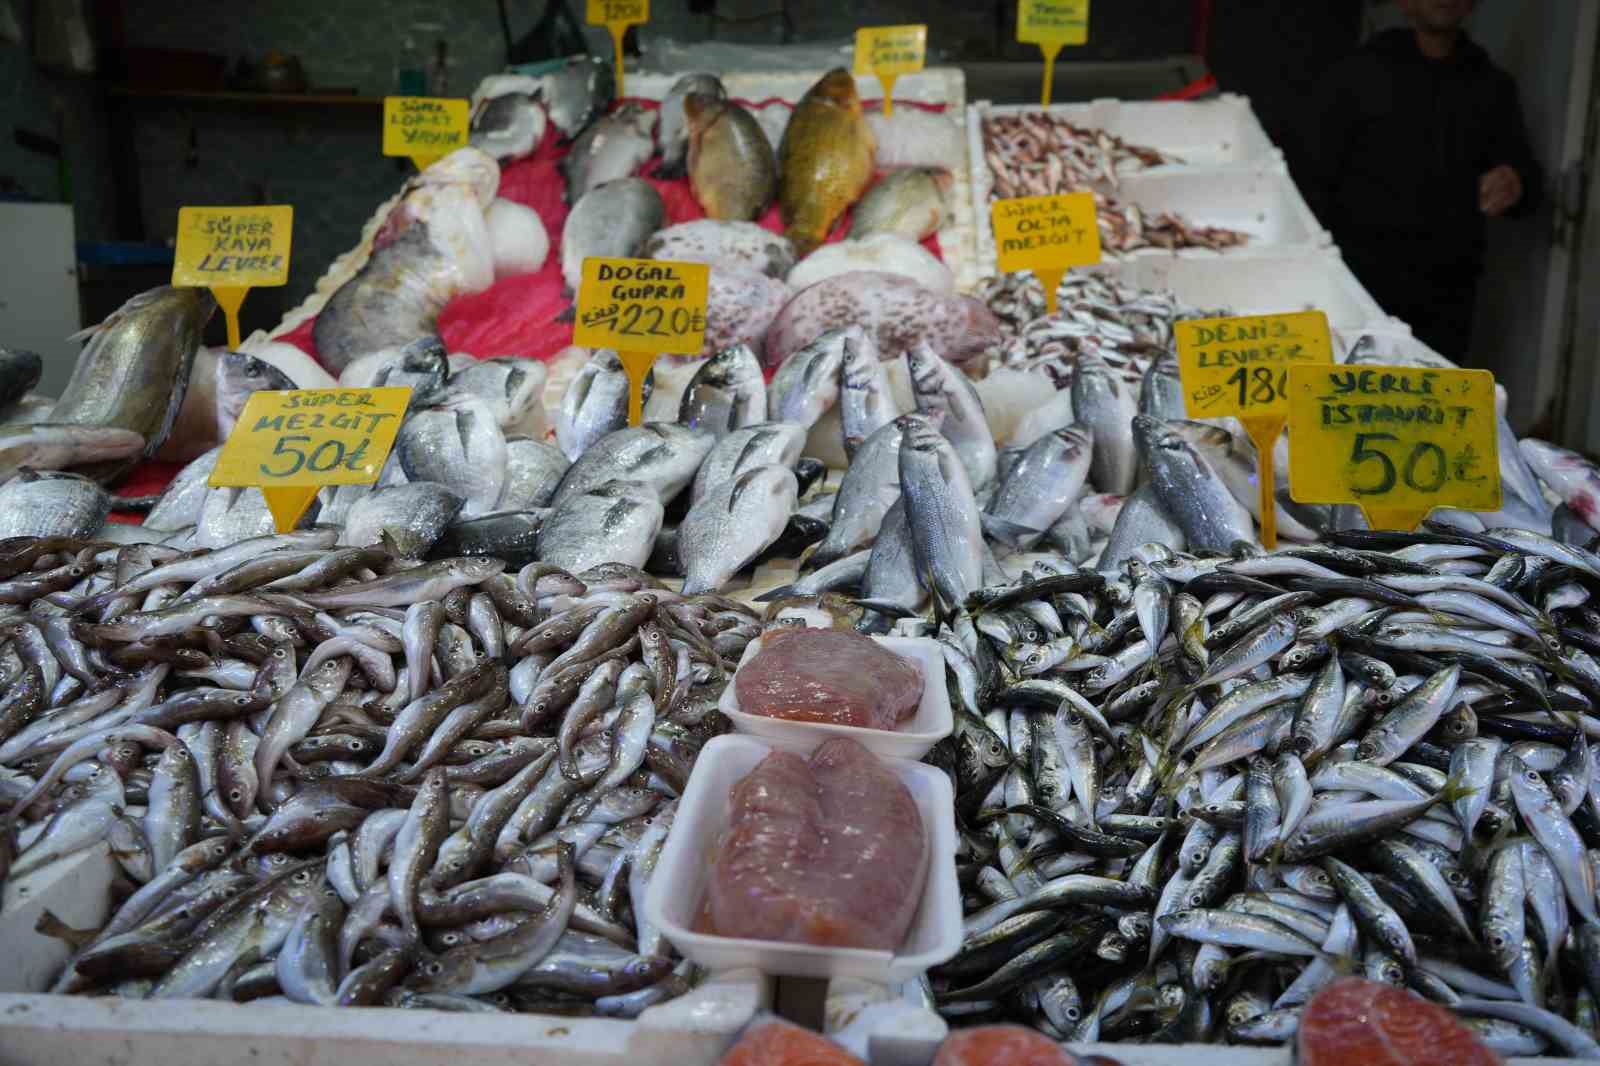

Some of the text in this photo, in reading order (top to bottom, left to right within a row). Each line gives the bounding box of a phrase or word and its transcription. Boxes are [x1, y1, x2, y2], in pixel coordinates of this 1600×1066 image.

[201, 215, 273, 235] SÜPER
[214, 236, 271, 252] KAYA
[1197, 344, 1316, 368] LEVREK
[281, 391, 377, 409] SÜPER
